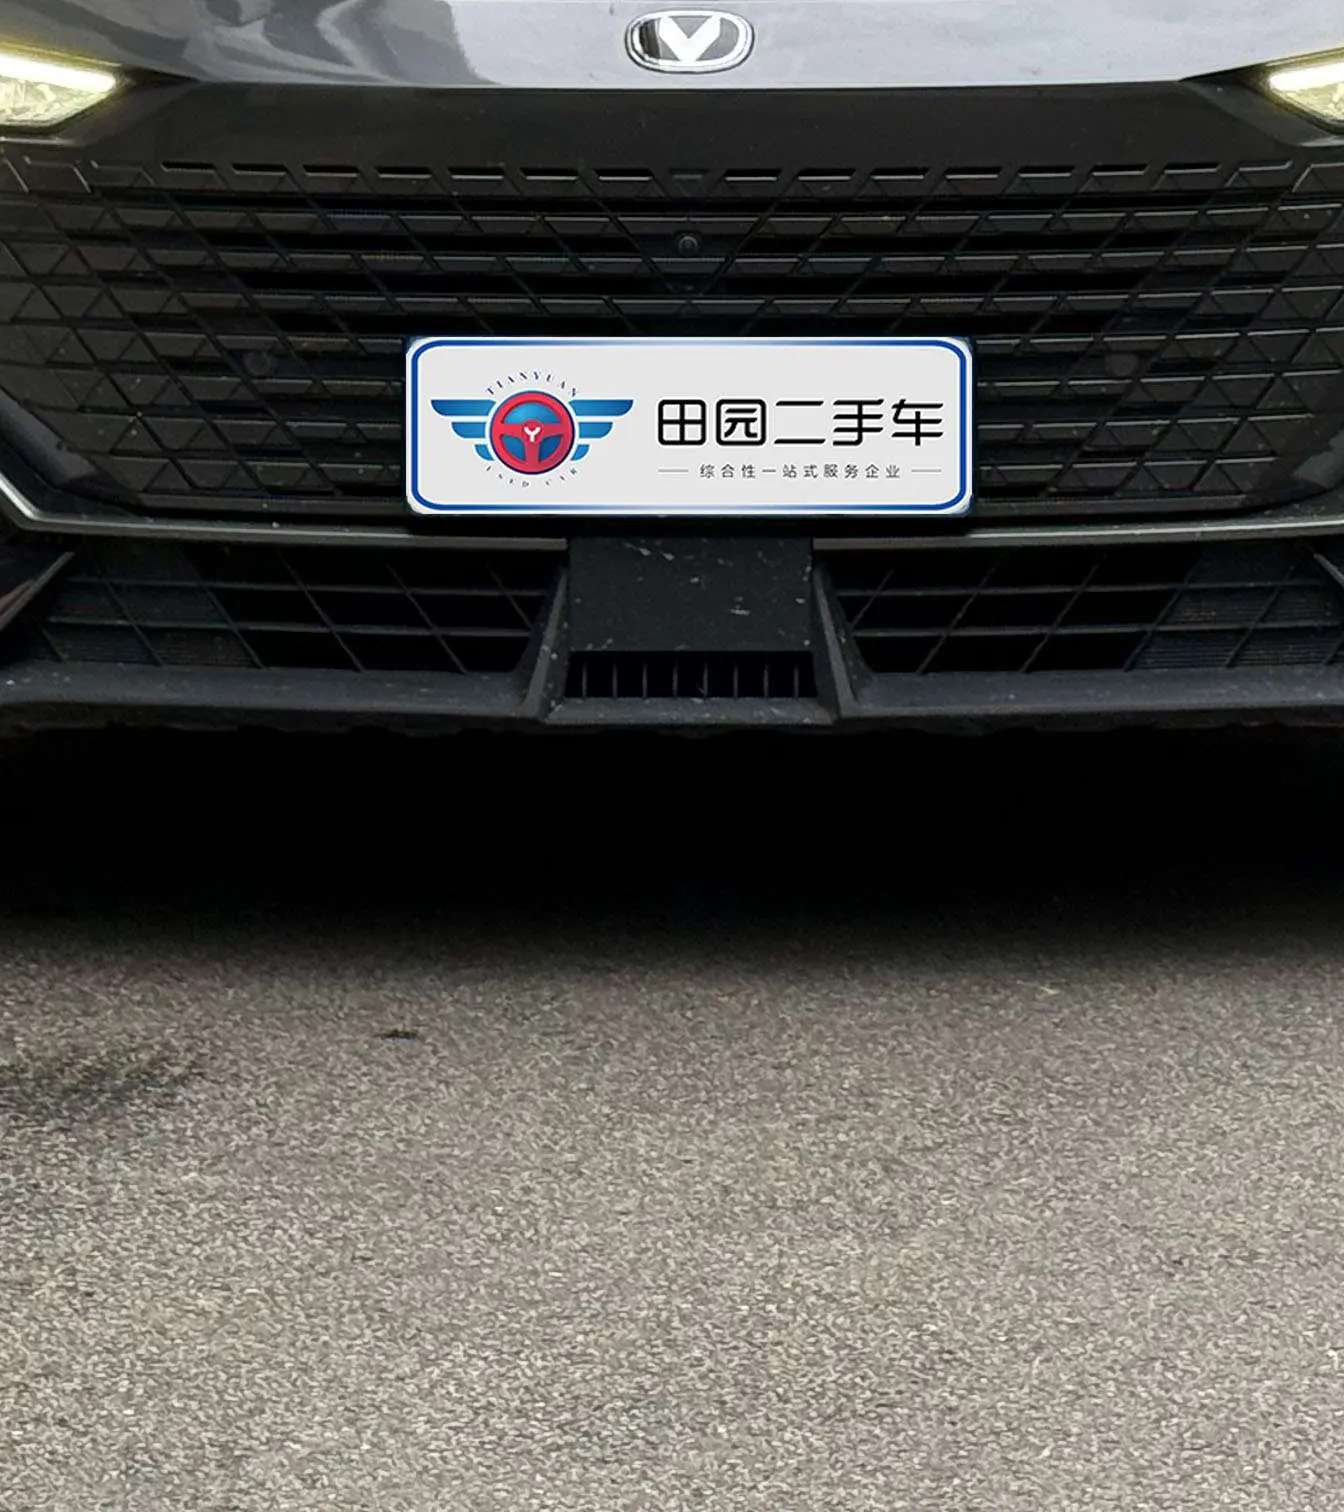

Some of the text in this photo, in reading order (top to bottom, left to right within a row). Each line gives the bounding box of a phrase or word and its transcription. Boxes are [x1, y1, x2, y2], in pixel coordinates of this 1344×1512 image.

[657, 398, 945, 447] 田园二手车
[699, 463, 900, 479] 综合性一站式服务企业
